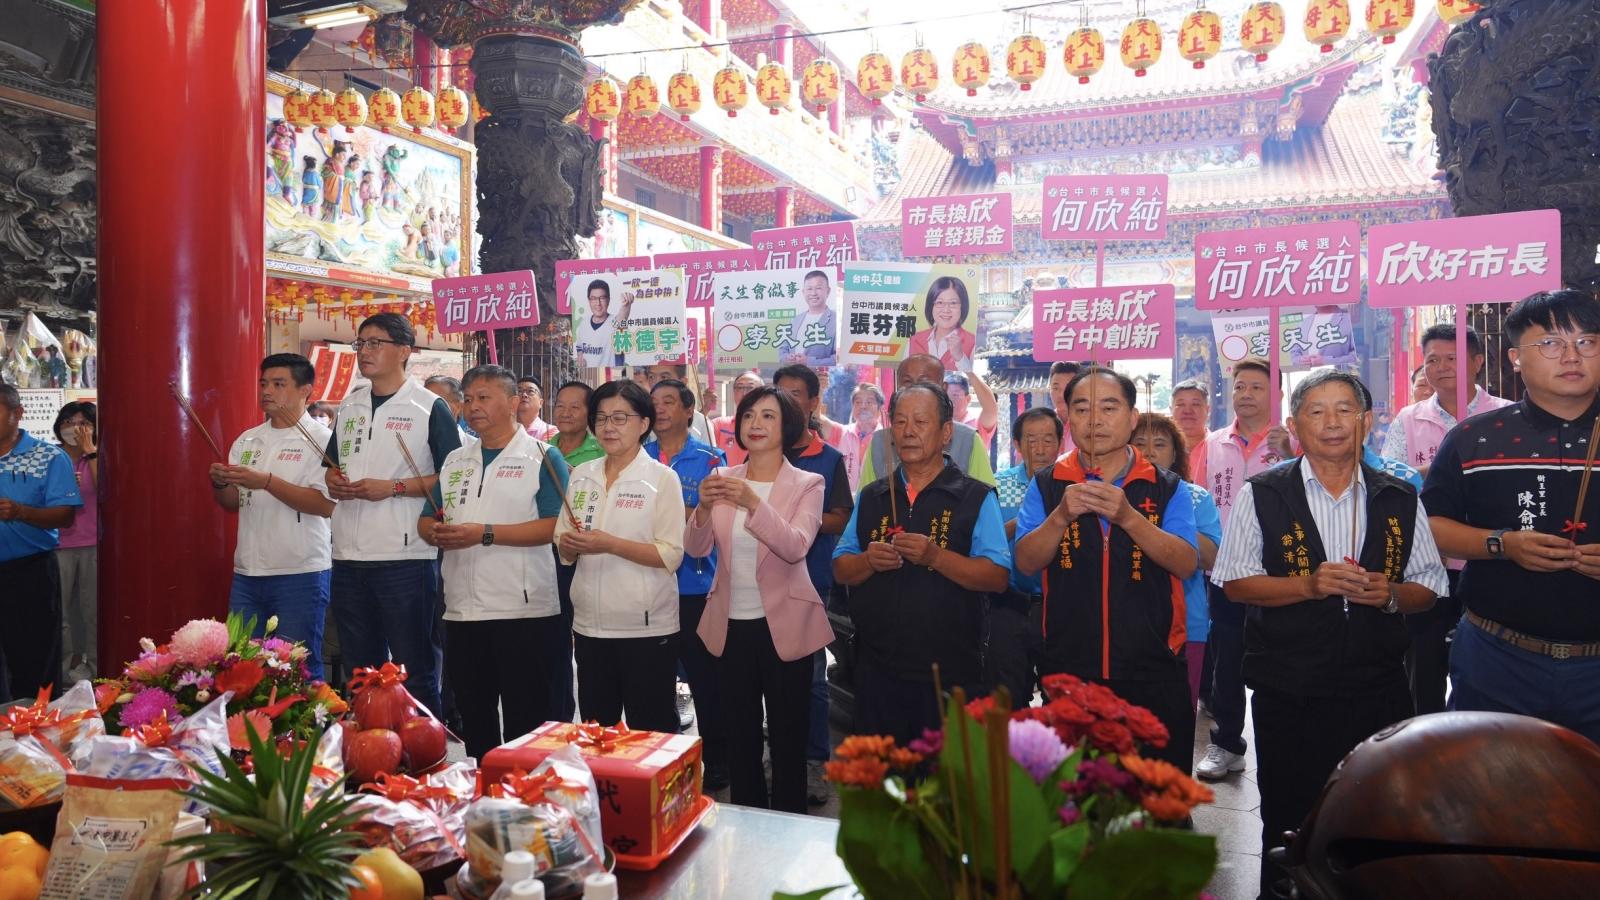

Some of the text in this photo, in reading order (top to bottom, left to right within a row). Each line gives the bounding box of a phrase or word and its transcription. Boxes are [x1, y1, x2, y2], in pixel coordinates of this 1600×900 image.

[1059, 186, 1162, 197] 台中市長候選人
[908, 196, 998, 226] 市長換欣
[1051, 197, 1163, 232] 何欣純
[766, 234, 850, 249] 台中市長候選人
[924, 224, 1005, 248] 普發現金
[1215, 235, 1351, 257] 台中市長候選人
[1208, 250, 1355, 300] 何欣純
[1376, 240, 1548, 285] 欣好市長
[447, 281, 529, 297] 台中市長候選人
[720, 281, 800, 301] 天生會做事
[444, 290, 532, 327] 何欣純
[851, 301, 917, 312] 台中市議員候選人
[1042, 289, 1158, 324] 市長換欣
[620, 316, 679, 327] 台中市議員候選人
[850, 312, 917, 338] 張芬郁
[613, 328, 679, 353] 林德宇
[743, 322, 831, 350] 李天生
[1052, 322, 1160, 351] 台中創新
[1250, 323, 1348, 356] 李天生
